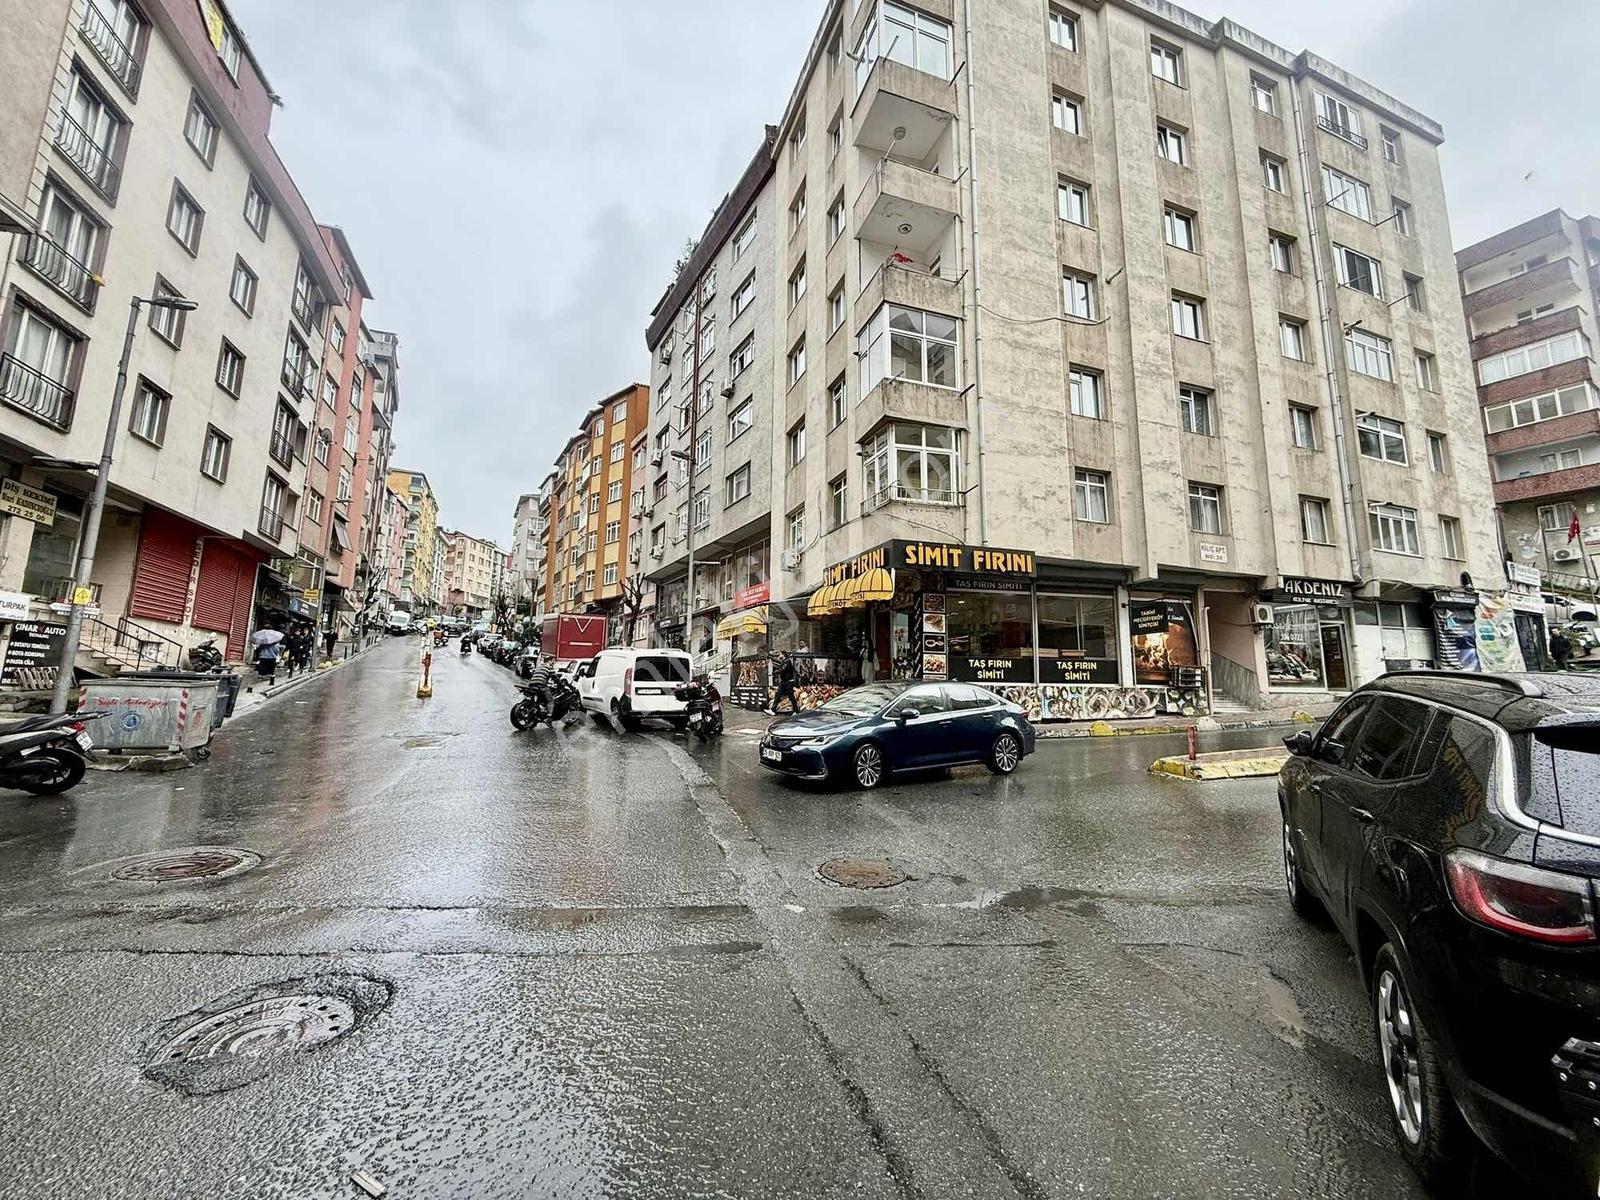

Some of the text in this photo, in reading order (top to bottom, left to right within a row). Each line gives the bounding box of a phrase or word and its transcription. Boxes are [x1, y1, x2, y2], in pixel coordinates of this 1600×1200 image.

[7, 505, 21, 515] 272
[23, 510, 34, 518] 25
[851, 547, 884, 579] FIRINI
[905, 543, 1033, 573] SİMİT FIRINI
[956, 580, 971, 588] TAŞ
[973, 581, 997, 590] FIRIN
[44, 627, 67, 636] AUTO
[968, 659, 1012, 668] TAŞ FIRIN
[1056, 661, 1097, 670] TAŞ FIRIN
[977, 669, 1004, 679] SİMİTİ
[1065, 671, 1090, 681] SİMİTİ
